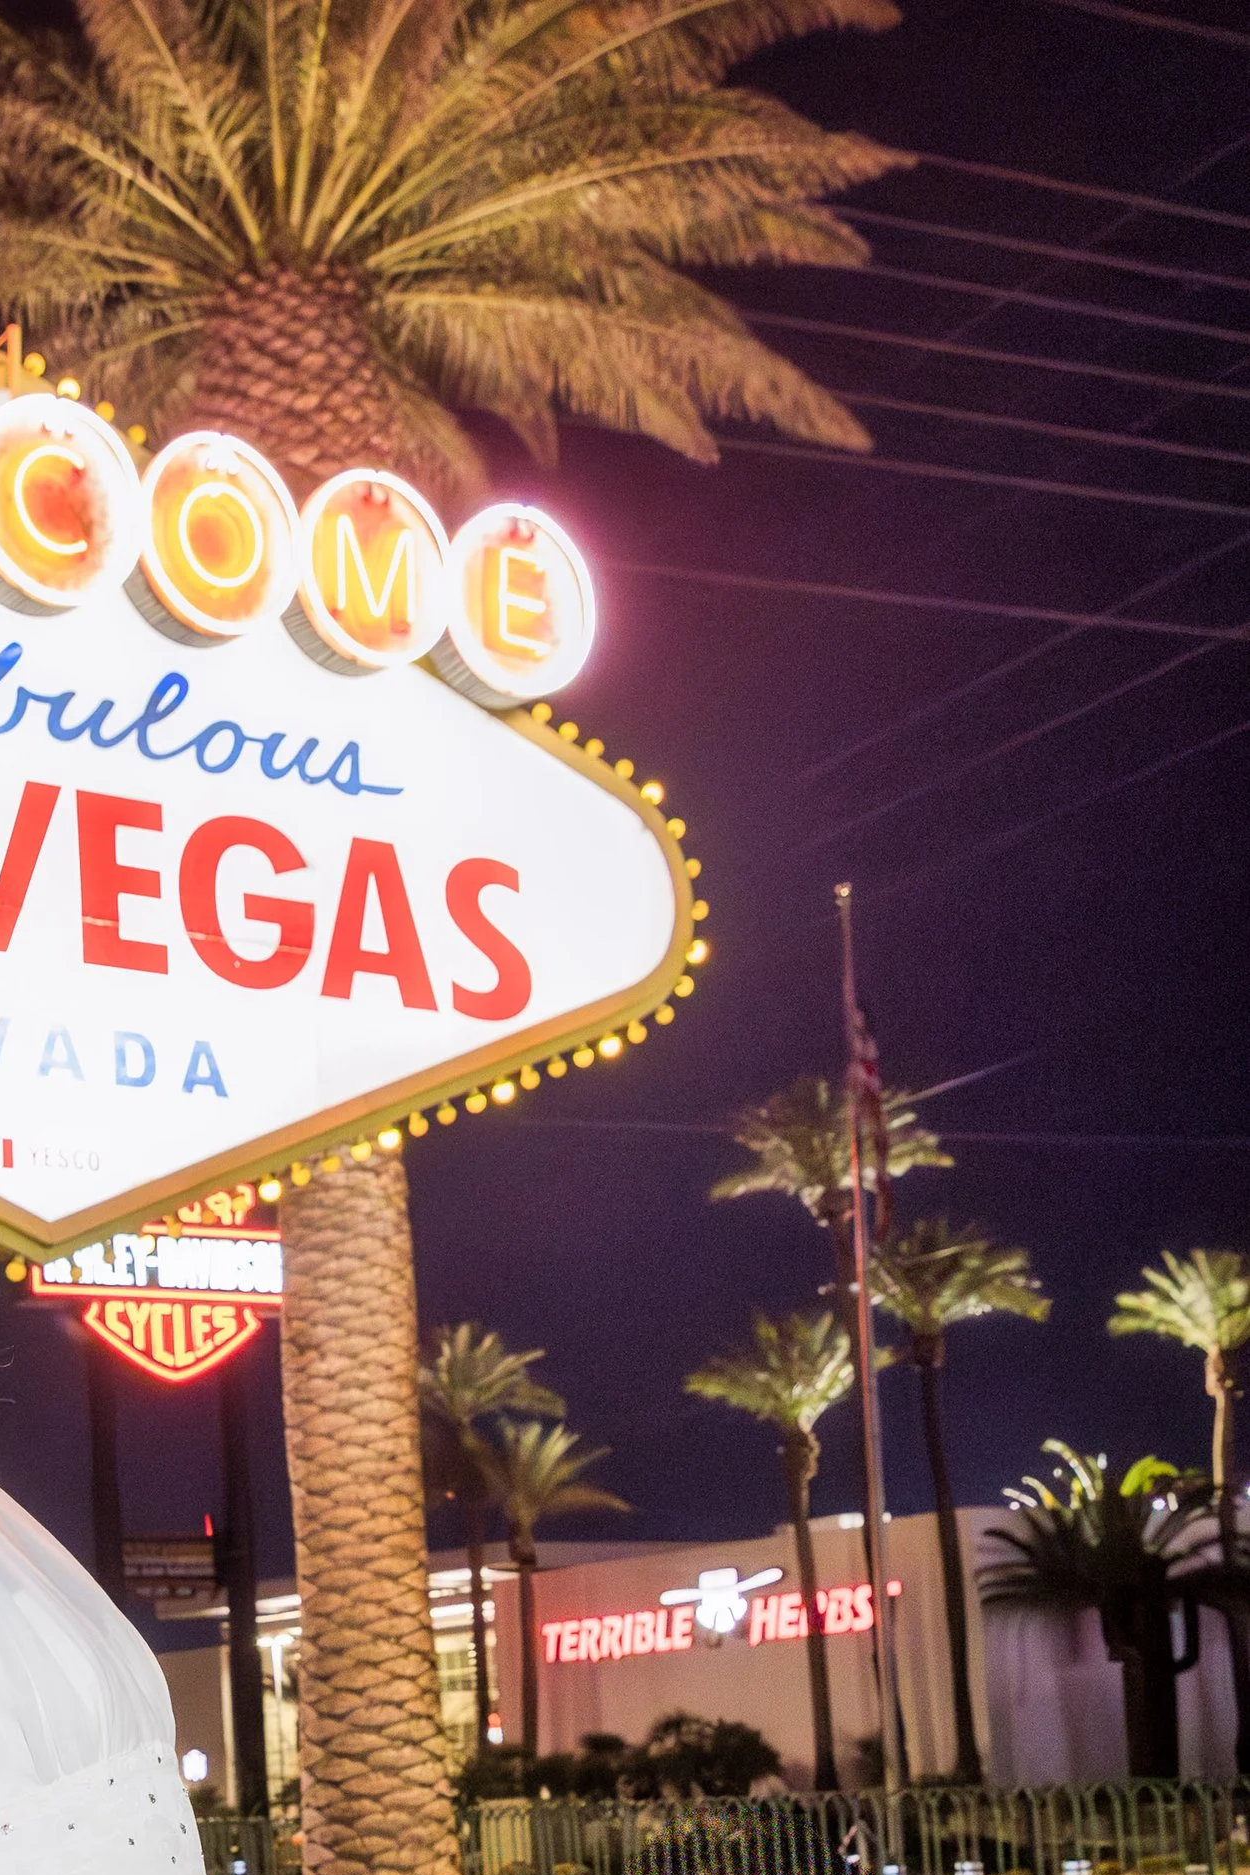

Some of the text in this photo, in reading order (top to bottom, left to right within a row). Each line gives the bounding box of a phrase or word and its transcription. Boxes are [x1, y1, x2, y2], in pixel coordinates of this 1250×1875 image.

[28, 1142, 102, 1172] YESCO
[104, 1300, 238, 1369] CYCLES
[541, 1604, 694, 1663] TERRIBLE
